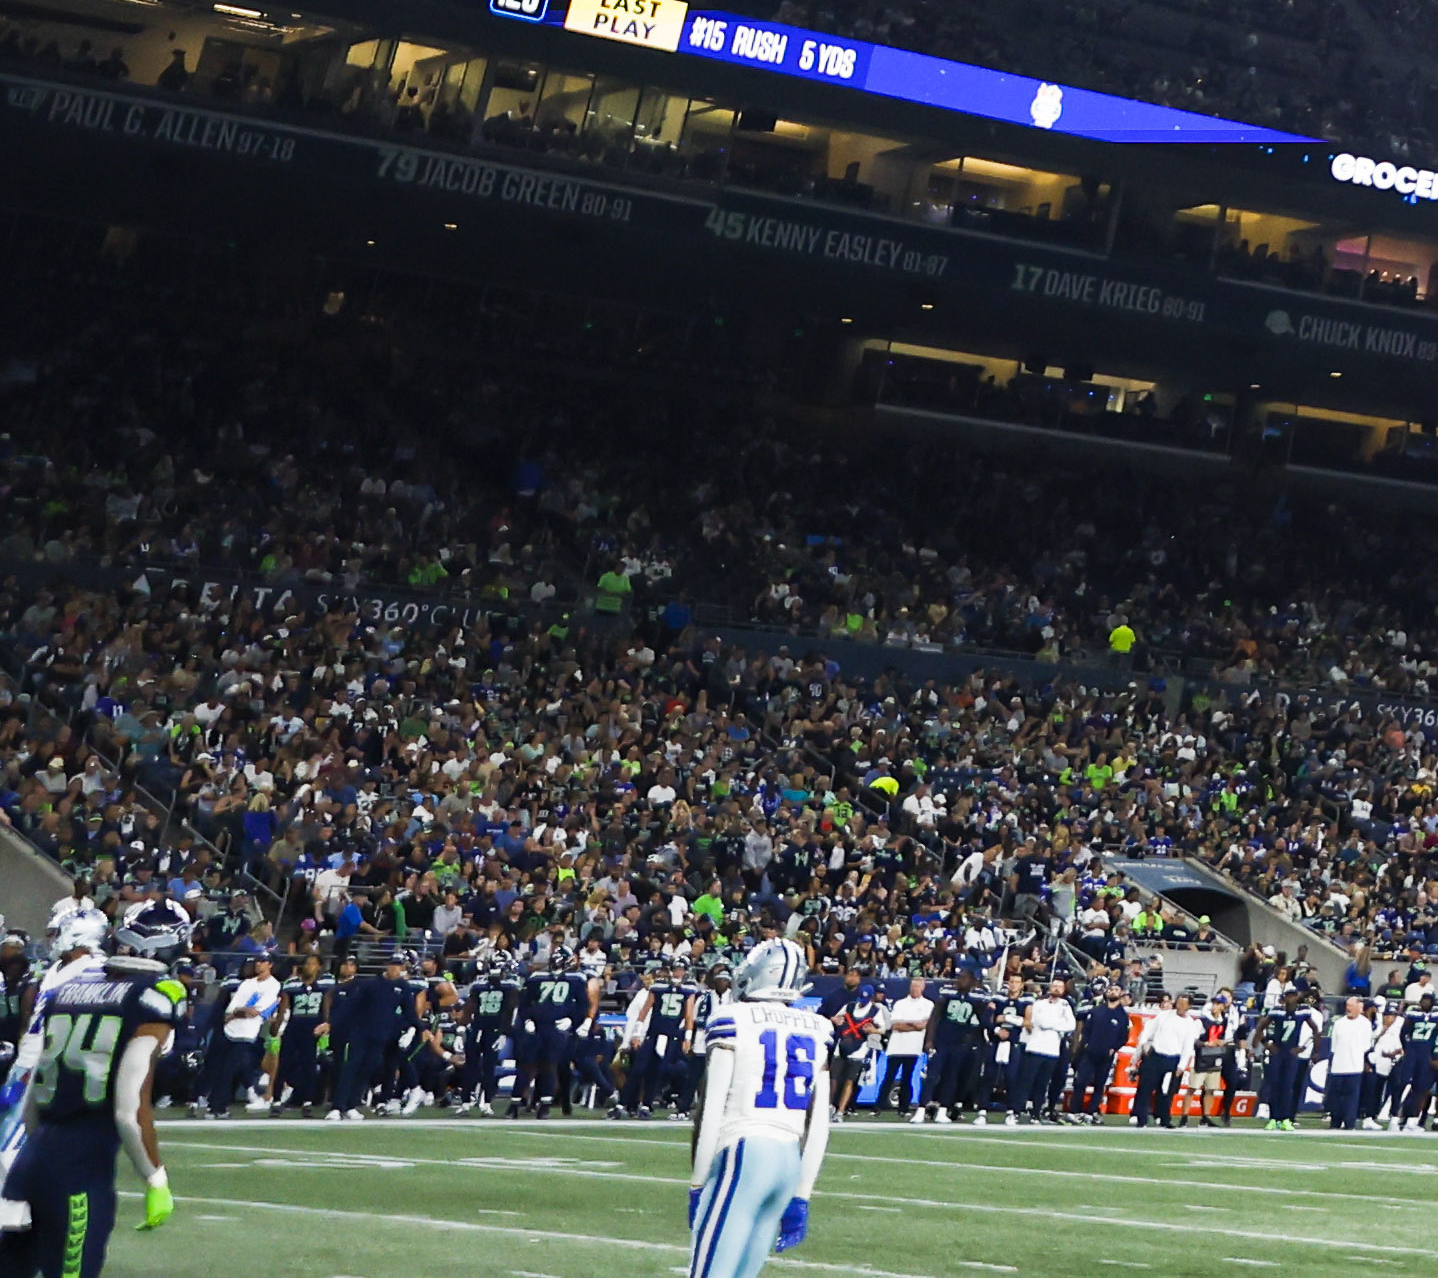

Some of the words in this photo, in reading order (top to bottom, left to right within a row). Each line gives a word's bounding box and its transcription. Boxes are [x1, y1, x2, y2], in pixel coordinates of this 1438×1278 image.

[593, 14, 656, 41] PLAY
[689, 16, 727, 51] #15
[733, 24, 788, 64] RUSH
[799, 40, 814, 70] 5
[818, 44, 857, 79] YDS
[48, 93, 116, 132] PAUL
[124, 103, 147, 137] G.
[155, 110, 237, 151] ALLEN
[378, 147, 419, 182] 79
[418, 156, 497, 198] JACOB
[502, 172, 582, 212] GREEN
[704, 207, 746, 239] 45
[747, 215, 821, 254] KENNY
[824, 229, 904, 268] EASLEY
[1011, 263, 1045, 291] 17
[1045, 270, 1096, 302] DAVE
[1100, 279, 1161, 314] KRIEG
[1299, 315, 1361, 347] CHUCK
[1366, 327, 1417, 359] KNOX
[55, 981, 133, 1006] FRANKLIN
[538, 981, 569, 1004] 70
[660, 993, 684, 1017] 15
[946, 1000, 972, 1024] 90
[1282, 1020, 1297, 1043] 7
[1411, 1021, 1437, 1041] 27
